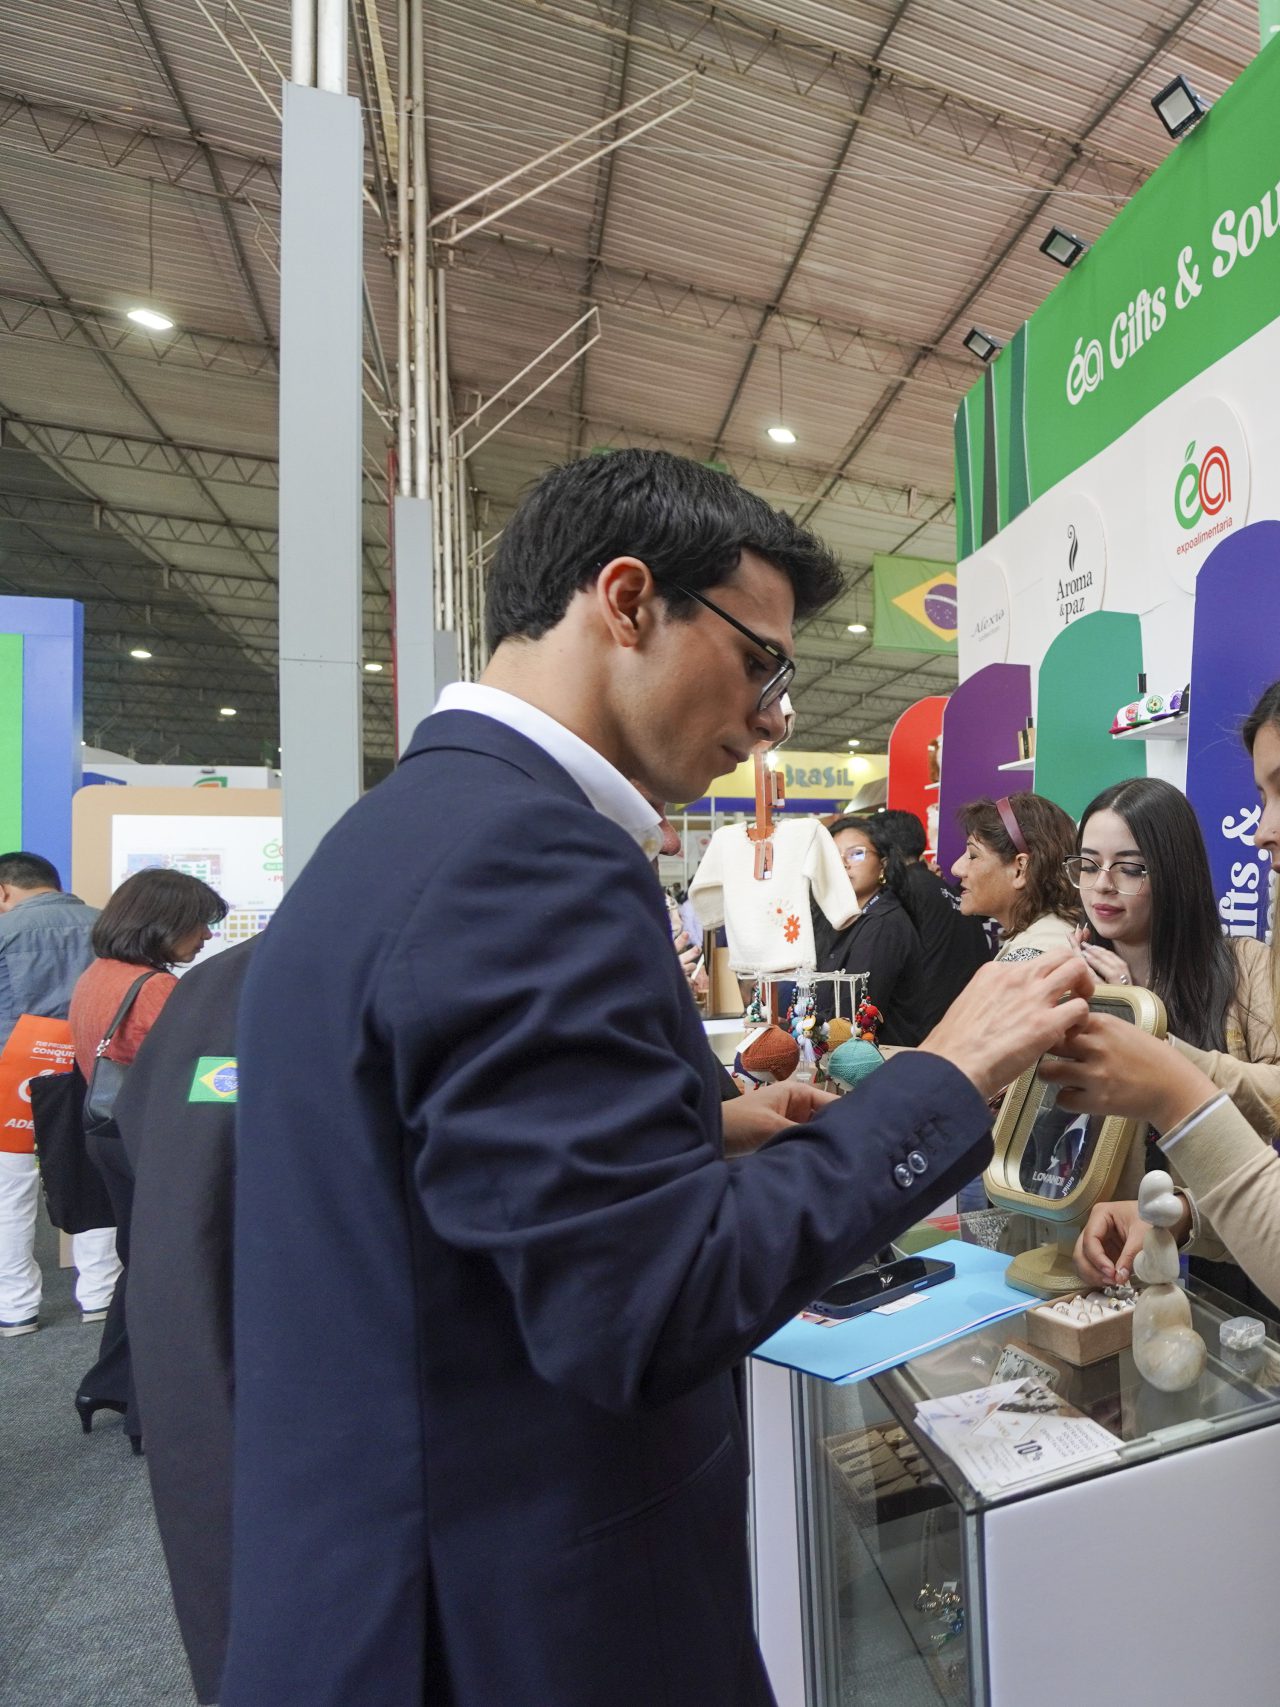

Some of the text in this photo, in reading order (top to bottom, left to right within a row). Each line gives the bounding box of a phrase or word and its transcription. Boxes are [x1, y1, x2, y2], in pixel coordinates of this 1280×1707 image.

[1109, 286, 1167, 370] Gifts
[1175, 245, 1203, 309] &
[1176, 517, 1233, 555] expoalimentaria
[1056, 570, 1092, 601] Aroma
[1222, 805, 1262, 846] &
[4, 1118, 34, 1130] ADE
[1013, 1440, 1043, 1461] 10%
